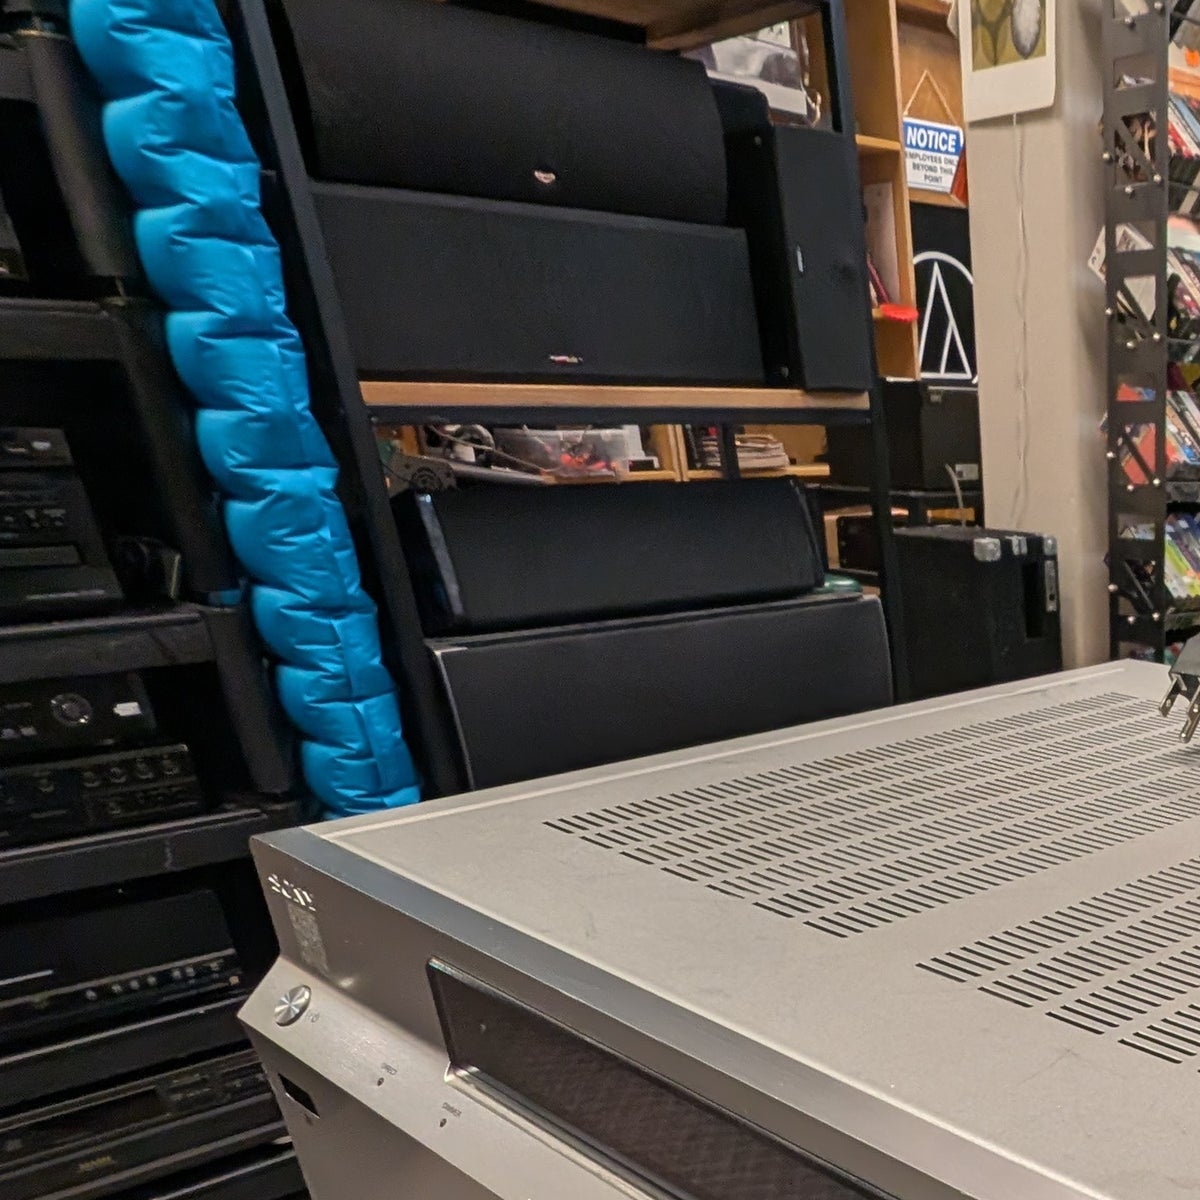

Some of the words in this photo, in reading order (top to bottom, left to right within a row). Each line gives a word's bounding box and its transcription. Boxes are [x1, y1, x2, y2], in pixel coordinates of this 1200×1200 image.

[906, 126, 957, 153] NOTICE
[912, 162, 938, 173] BEYOND
[924, 174, 943, 184] POINT
